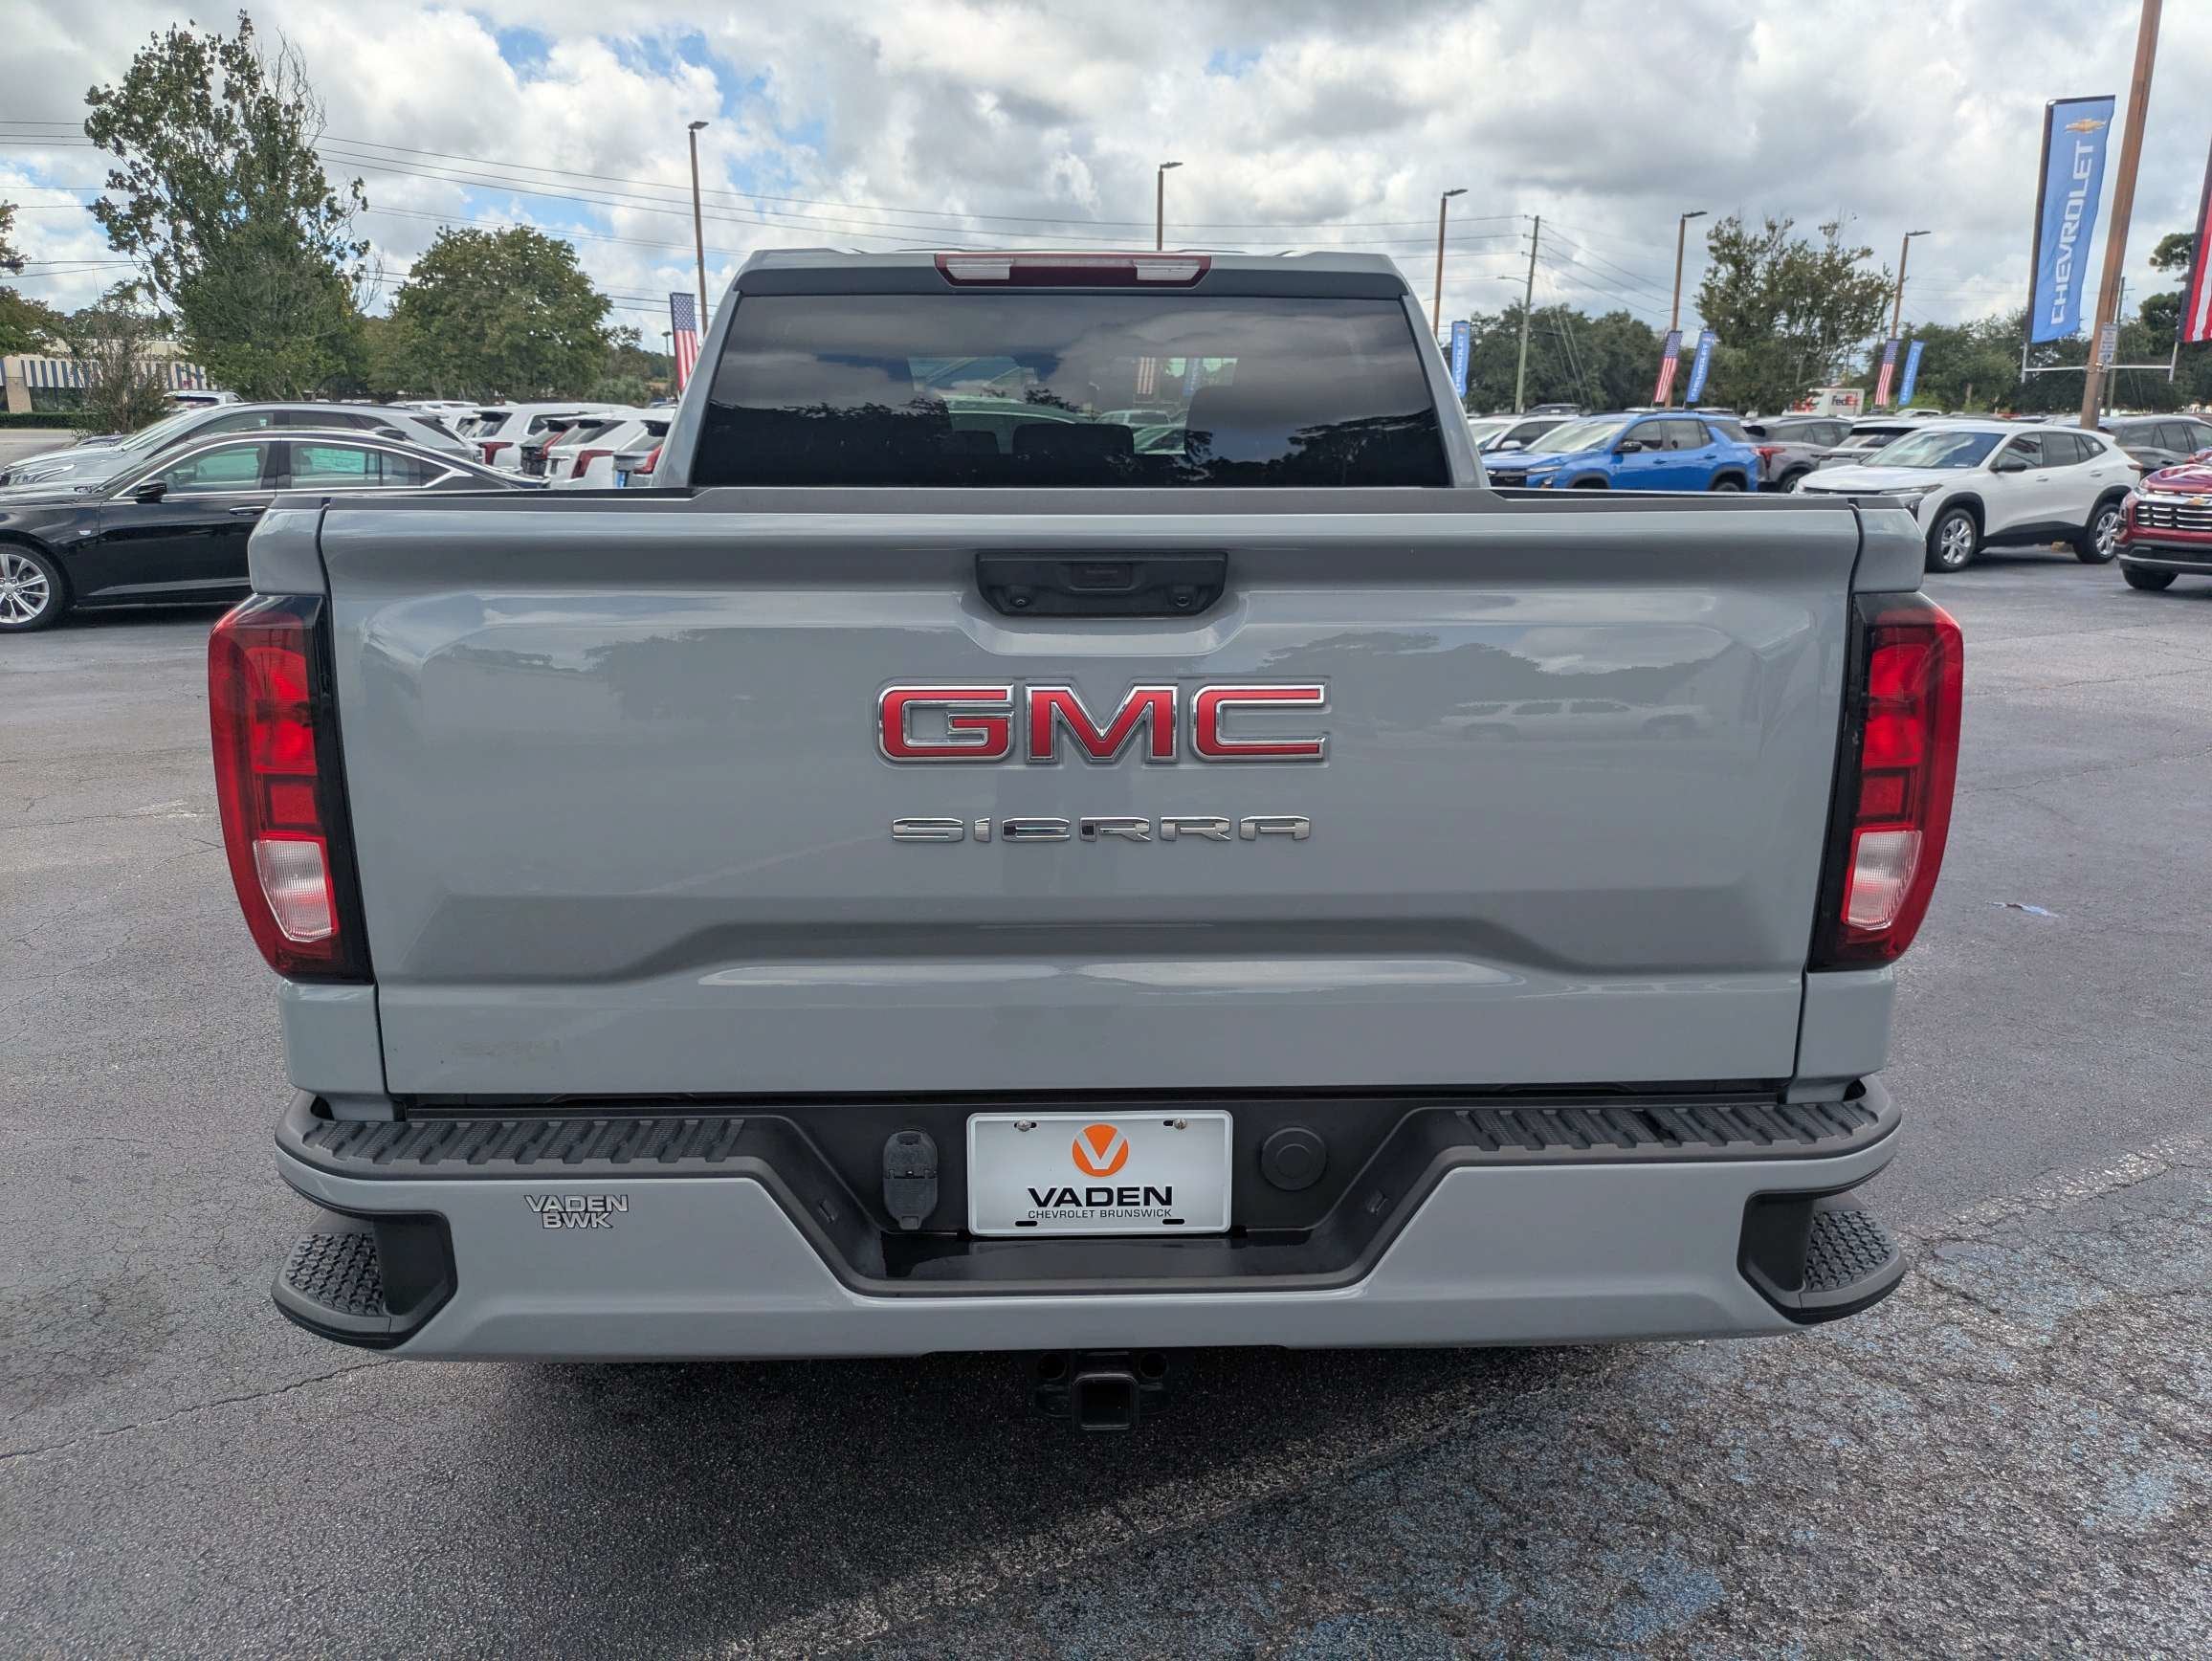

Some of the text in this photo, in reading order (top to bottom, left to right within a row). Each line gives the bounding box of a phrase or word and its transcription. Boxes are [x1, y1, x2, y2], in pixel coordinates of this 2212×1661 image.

[2050, 141, 2094, 325] CHEVROLET
[875, 683, 1328, 764] GMC
[891, 816, 1311, 842] SIERRA
[523, 1194, 629, 1212] VADEN
[1028, 1186, 1173, 1207] VADEN
[542, 1211, 613, 1229] BWK
[1028, 1208, 1172, 1219] CHEVROLET BRUNSWICK
